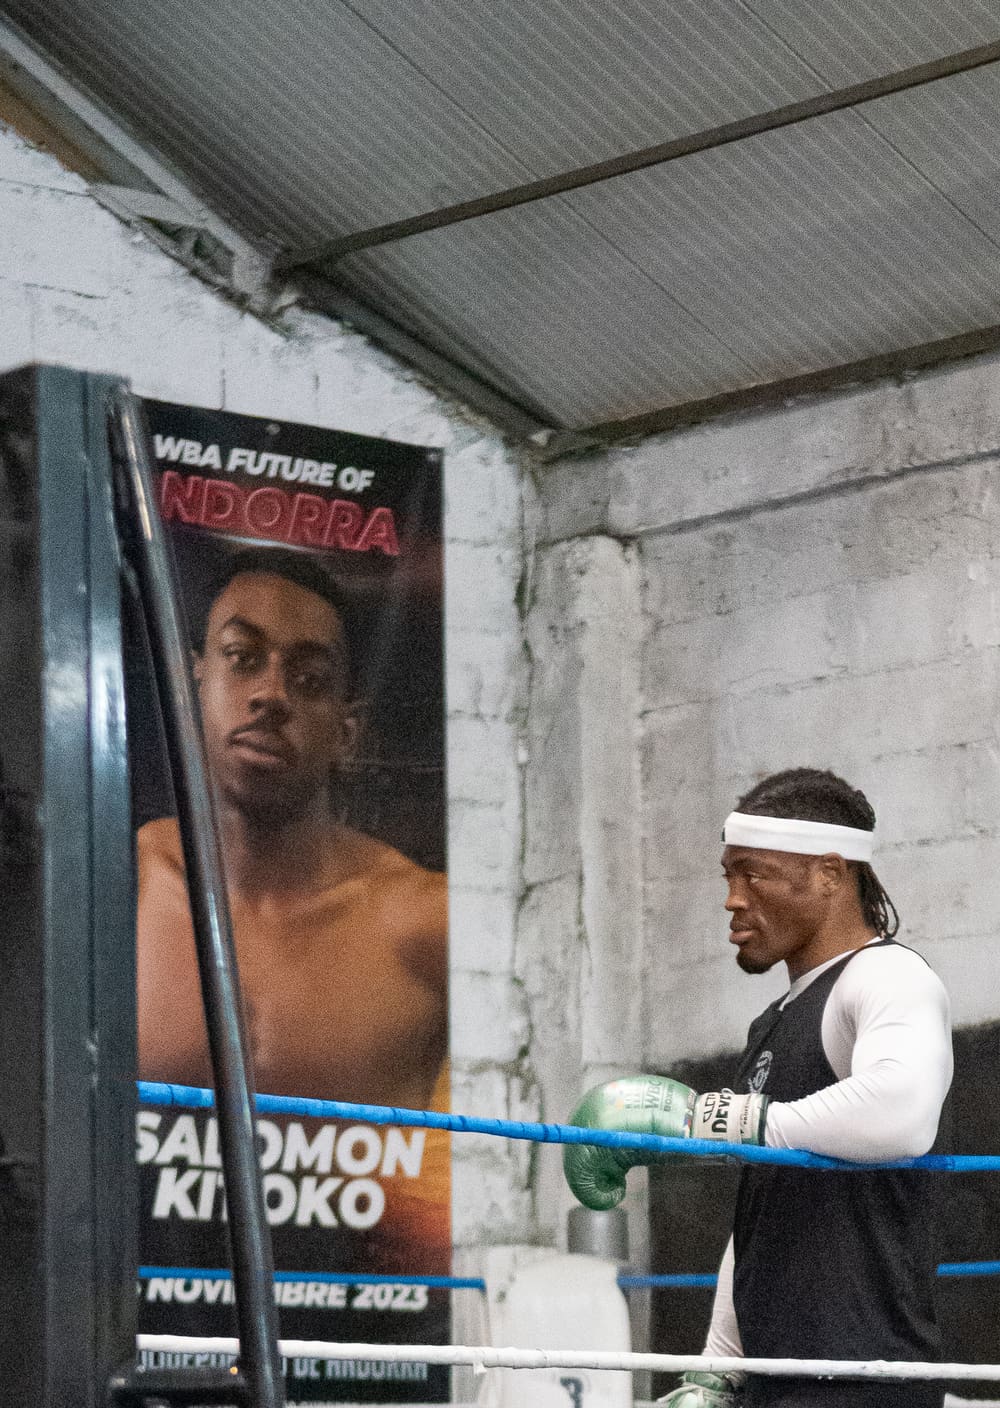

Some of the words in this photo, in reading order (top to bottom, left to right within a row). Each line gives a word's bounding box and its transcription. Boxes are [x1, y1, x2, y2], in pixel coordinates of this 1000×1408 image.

[153, 433, 222, 470] WBA
[226, 449, 337, 486] FUTURE
[338, 465, 376, 493] OF
[159, 470, 401, 556] NDORRA
[352, 1281, 429, 1311] 2023
